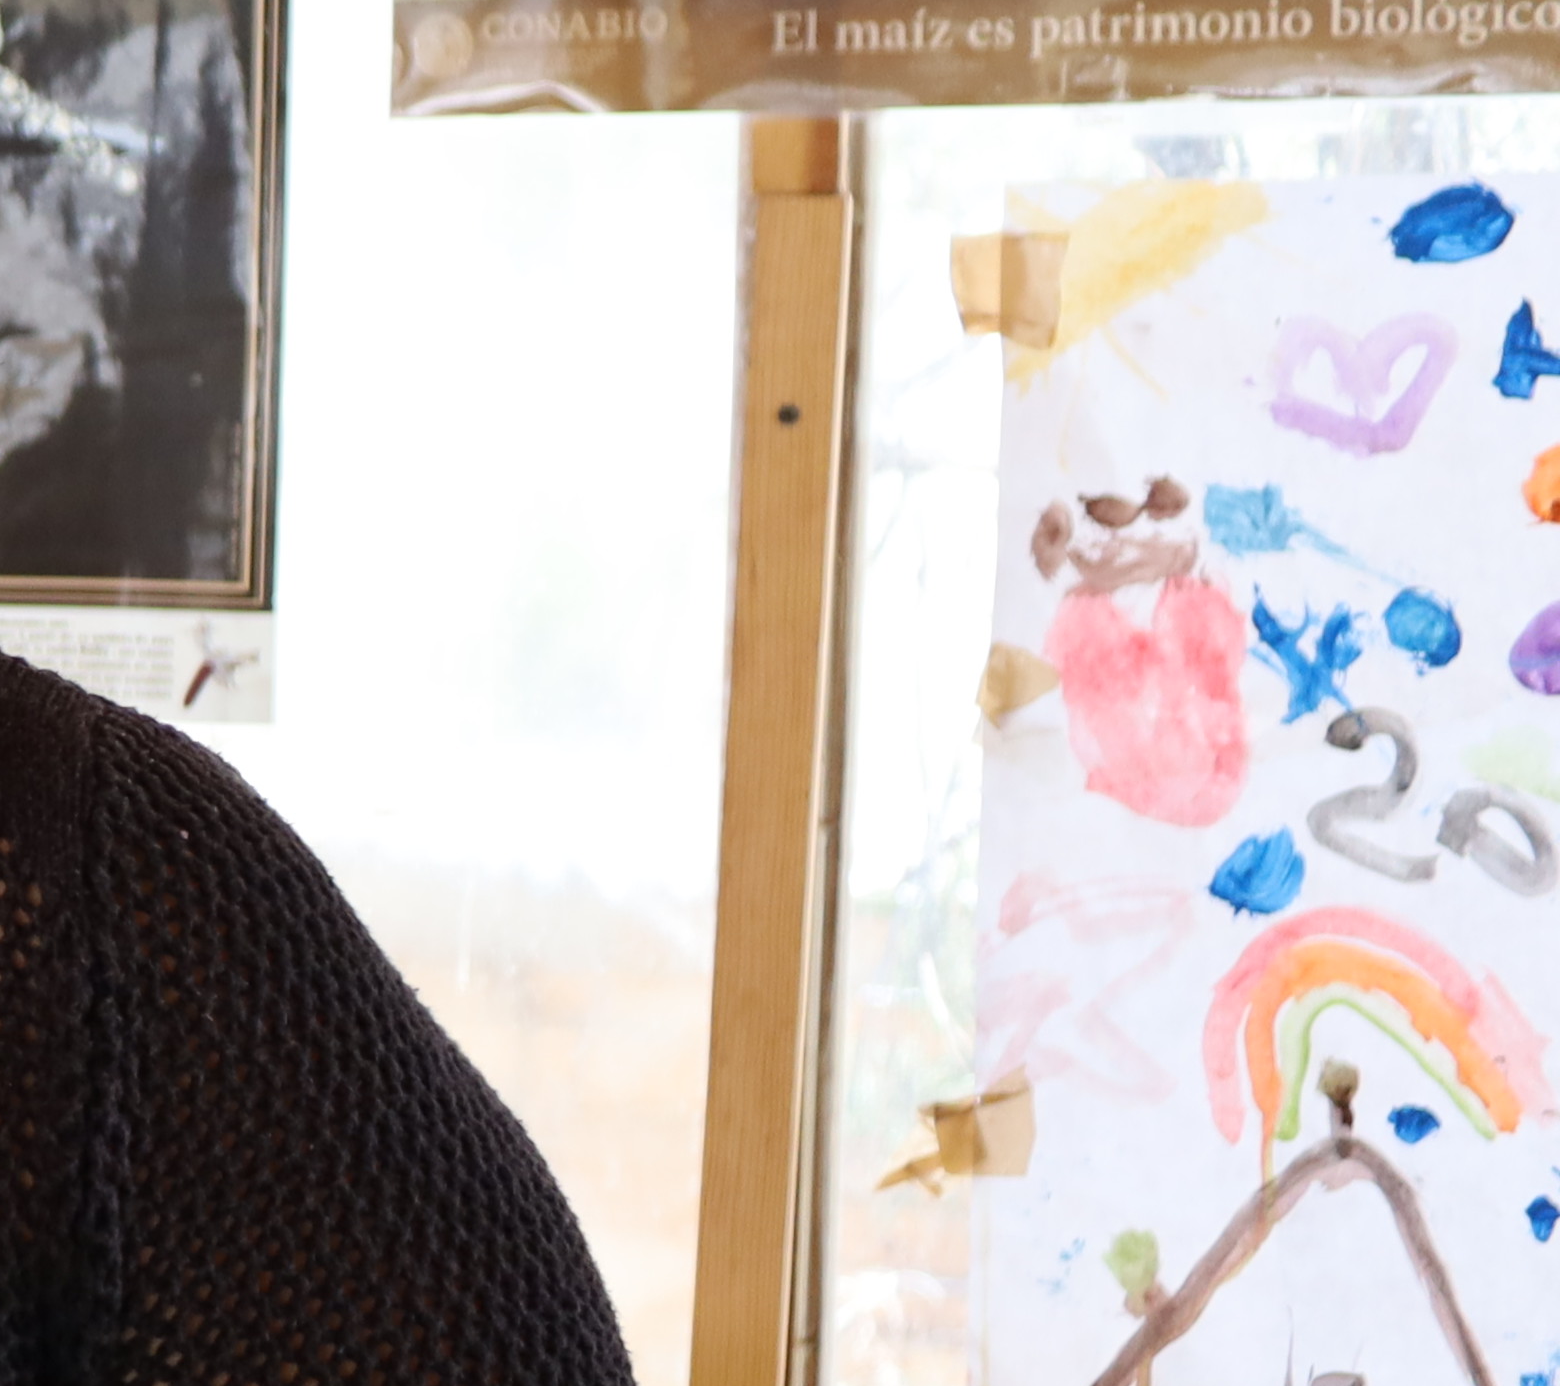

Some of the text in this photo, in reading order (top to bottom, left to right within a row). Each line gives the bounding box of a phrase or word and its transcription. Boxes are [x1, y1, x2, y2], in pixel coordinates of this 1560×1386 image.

[482, 7, 669, 42] CONABIO
[772, 8, 818, 54] El
[833, 7, 954, 53] maíz
[967, 15, 1015, 50] es
